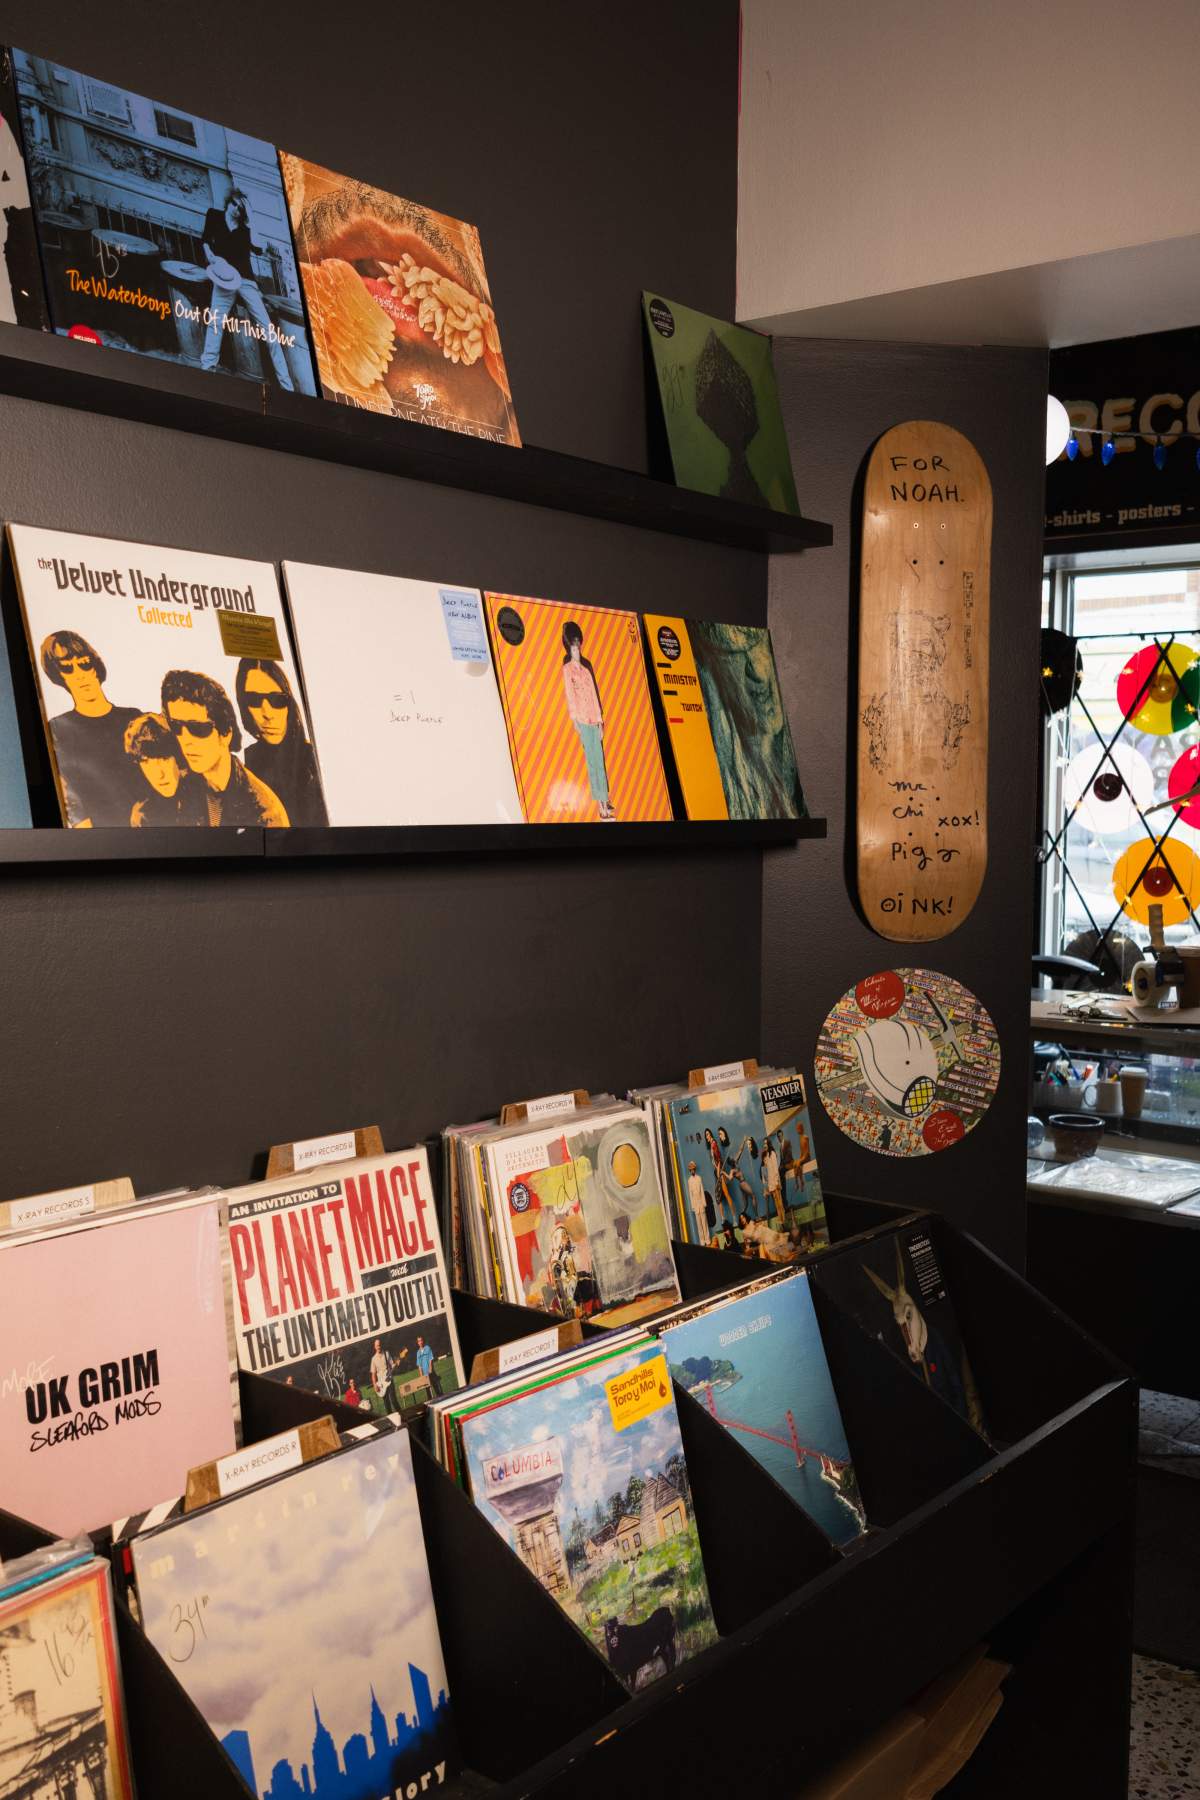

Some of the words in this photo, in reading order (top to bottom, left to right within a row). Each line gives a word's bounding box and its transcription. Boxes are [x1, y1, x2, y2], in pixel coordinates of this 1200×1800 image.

[66, 268, 91, 294] The
[91, 276, 172, 321] Waterboys
[174, 299, 201, 323] Out
[202, 309, 220, 335] Of
[222, 315, 241, 334] All
[241, 318, 268, 342] This
[268, 322, 297, 348] Blue
[889, 455, 951, 472] FOR
[890, 481, 965, 503] NOAH.
[1044, 510, 1101, 528] -shirts
[1118, 504, 1182, 526] posters
[37, 557, 53, 571] the
[52, 558, 127, 598] Velvet
[128, 568, 257, 614] Underground
[136, 604, 194, 629] Collected
[663, 673, 697, 687] MINISTRY
[762, 1081, 801, 1101] YEASAYER
[298, 1149, 318, 1160] X-RAY
[317, 1142, 348, 1156] RECORDS
[17, 1208, 43, 1225] X-RAY
[44, 1198, 83, 1214] RECORDS
[231, 1205, 250, 1218] AN
[253, 1188, 318, 1213] INVITATION
[322, 1185, 338, 1195] TO
[229, 1199, 356, 1326] PLANET
[344, 1161, 435, 1271] MACE
[390, 1263, 409, 1278] with
[242, 1320, 285, 1371] THE
[283, 1292, 380, 1358] UNTAMED
[377, 1272, 446, 1327] YOUTH!
[522, 1342, 551, 1361] RECORDS
[25, 1375, 72, 1425] UK
[78, 1349, 160, 1408] GRIM
[610, 1368, 654, 1395] Sandhills
[613, 1391, 633, 1408] Toro
[632, 1387, 641, 1402] y
[640, 1377, 656, 1394] Moi
[30, 1411, 109, 1452] SLEAFORD
[115, 1391, 162, 1425] MODS
[224, 1462, 251, 1481] X-RAY
[251, 1444, 291, 1469] RECORDS
[291, 1441, 297, 1450] R
